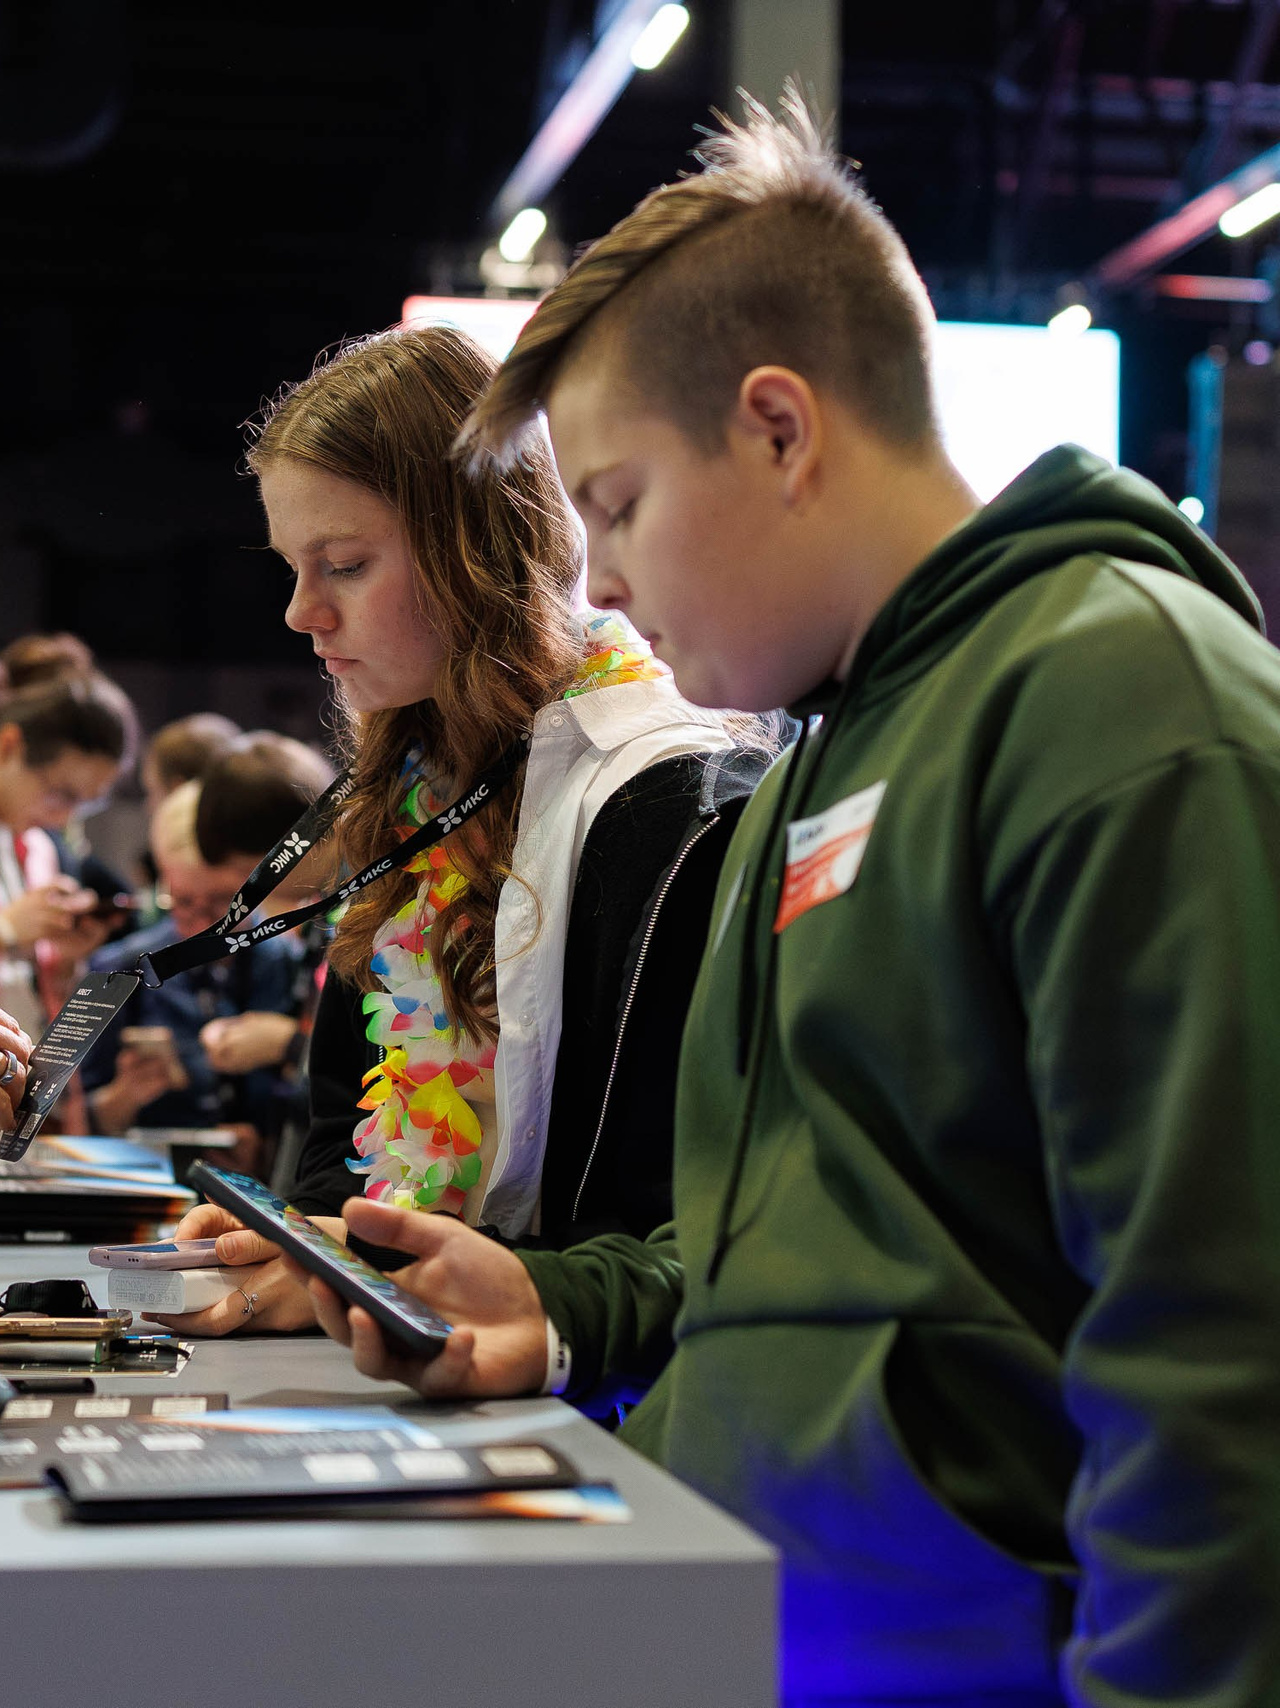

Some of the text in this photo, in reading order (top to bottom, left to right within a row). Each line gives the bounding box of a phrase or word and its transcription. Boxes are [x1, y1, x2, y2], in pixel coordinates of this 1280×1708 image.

[331, 777, 357, 805] ИКС
[459, 783, 490, 814] ИКС
[269, 848, 294, 873] ИКС
[360, 858, 393, 884] ИКС
[251, 919, 287, 940] ИКС
